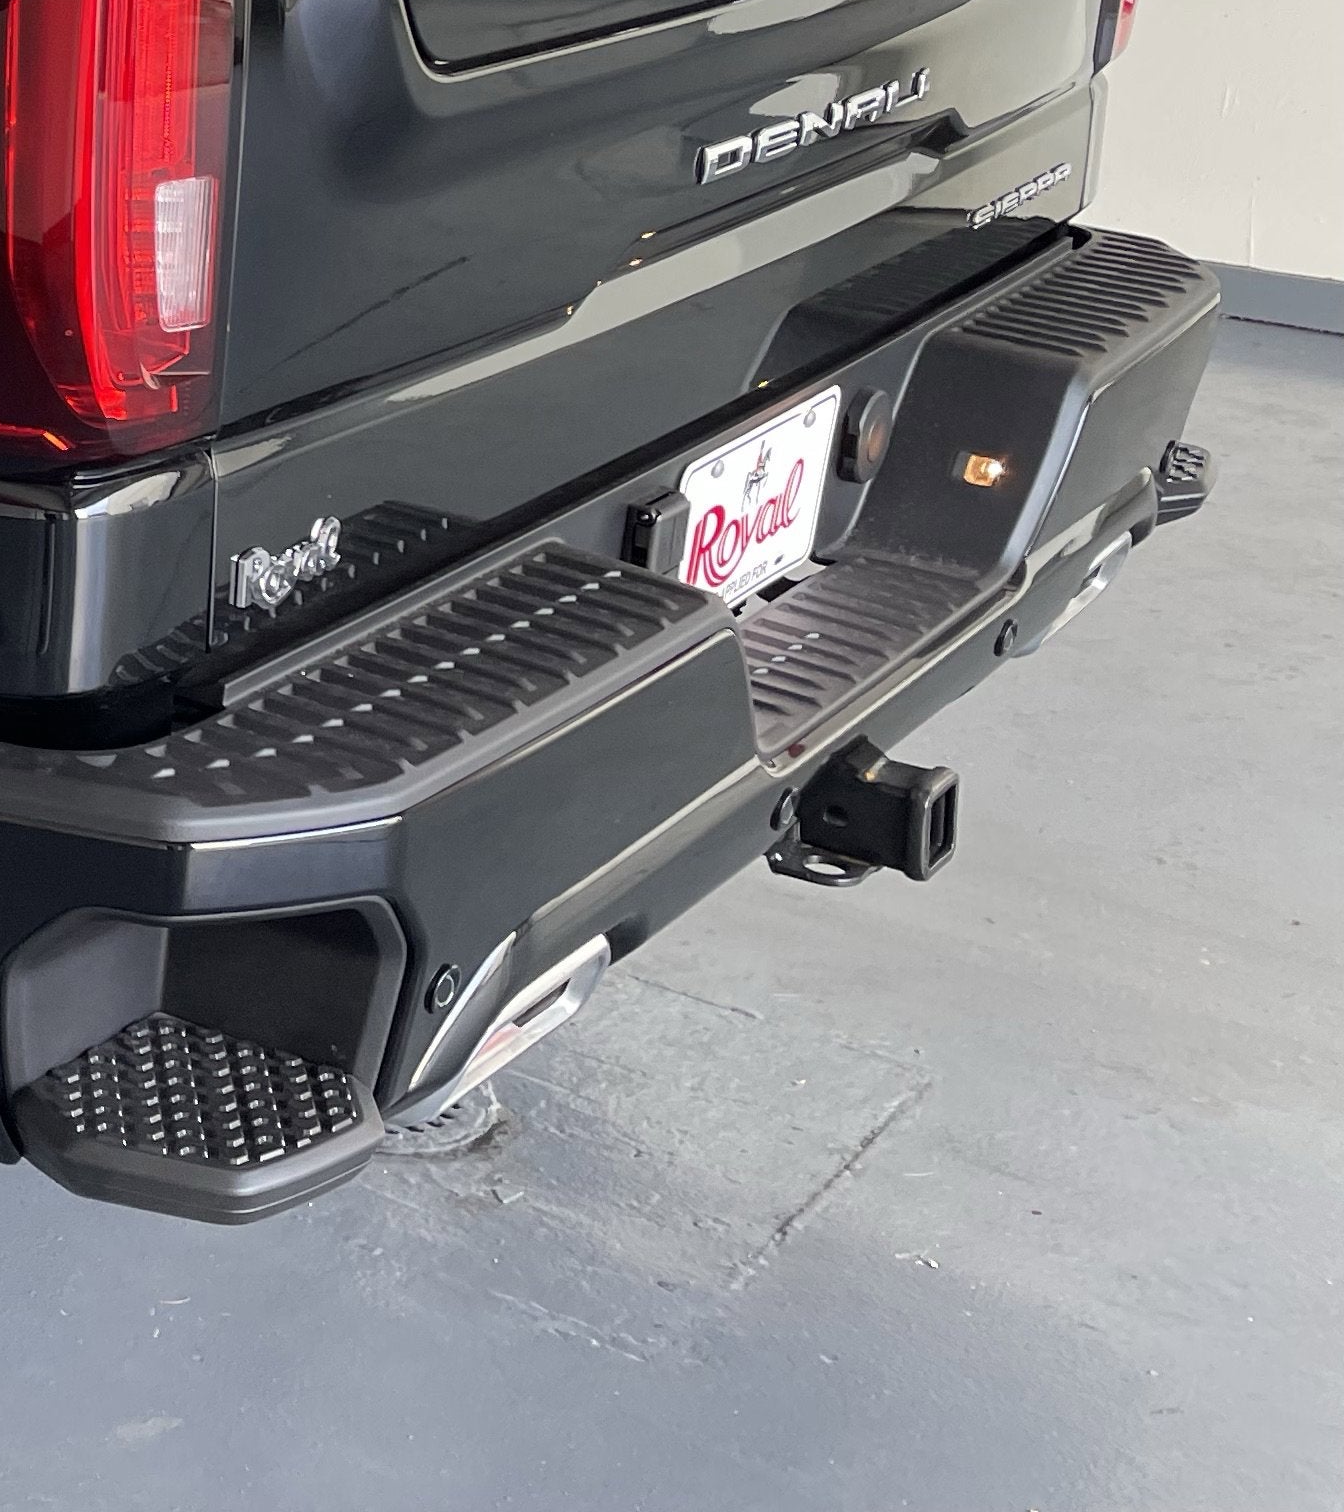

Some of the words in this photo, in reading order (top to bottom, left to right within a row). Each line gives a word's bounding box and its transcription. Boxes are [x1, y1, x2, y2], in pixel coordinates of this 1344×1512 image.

[694, 67, 930, 185] DENALI
[968, 162, 1072, 230] SIERRA
[686, 458, 804, 588] Royal
[752, 560, 768, 581] FOR
